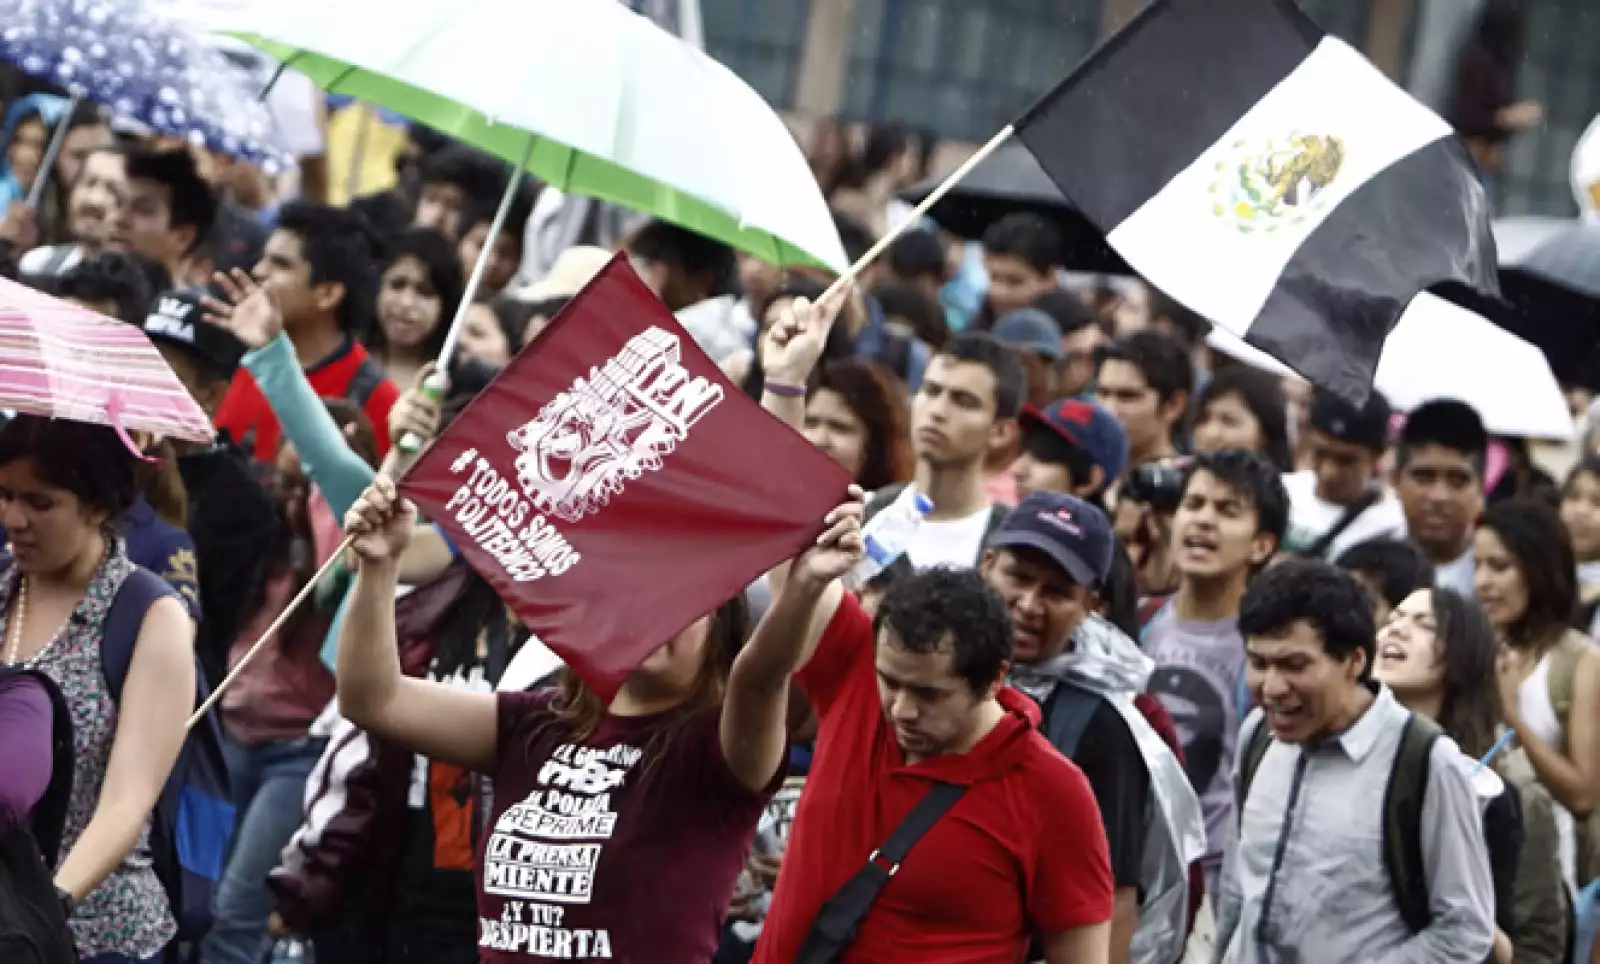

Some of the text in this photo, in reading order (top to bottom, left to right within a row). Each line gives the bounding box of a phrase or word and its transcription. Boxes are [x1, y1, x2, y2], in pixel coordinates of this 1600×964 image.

[518, 514, 581, 576] SOMOS
[503, 807, 613, 834] REPRIME
[488, 836, 594, 869] LA PRENSA
[487, 861, 590, 895] MIENTE
[479, 916, 613, 960] DESPIERTA
